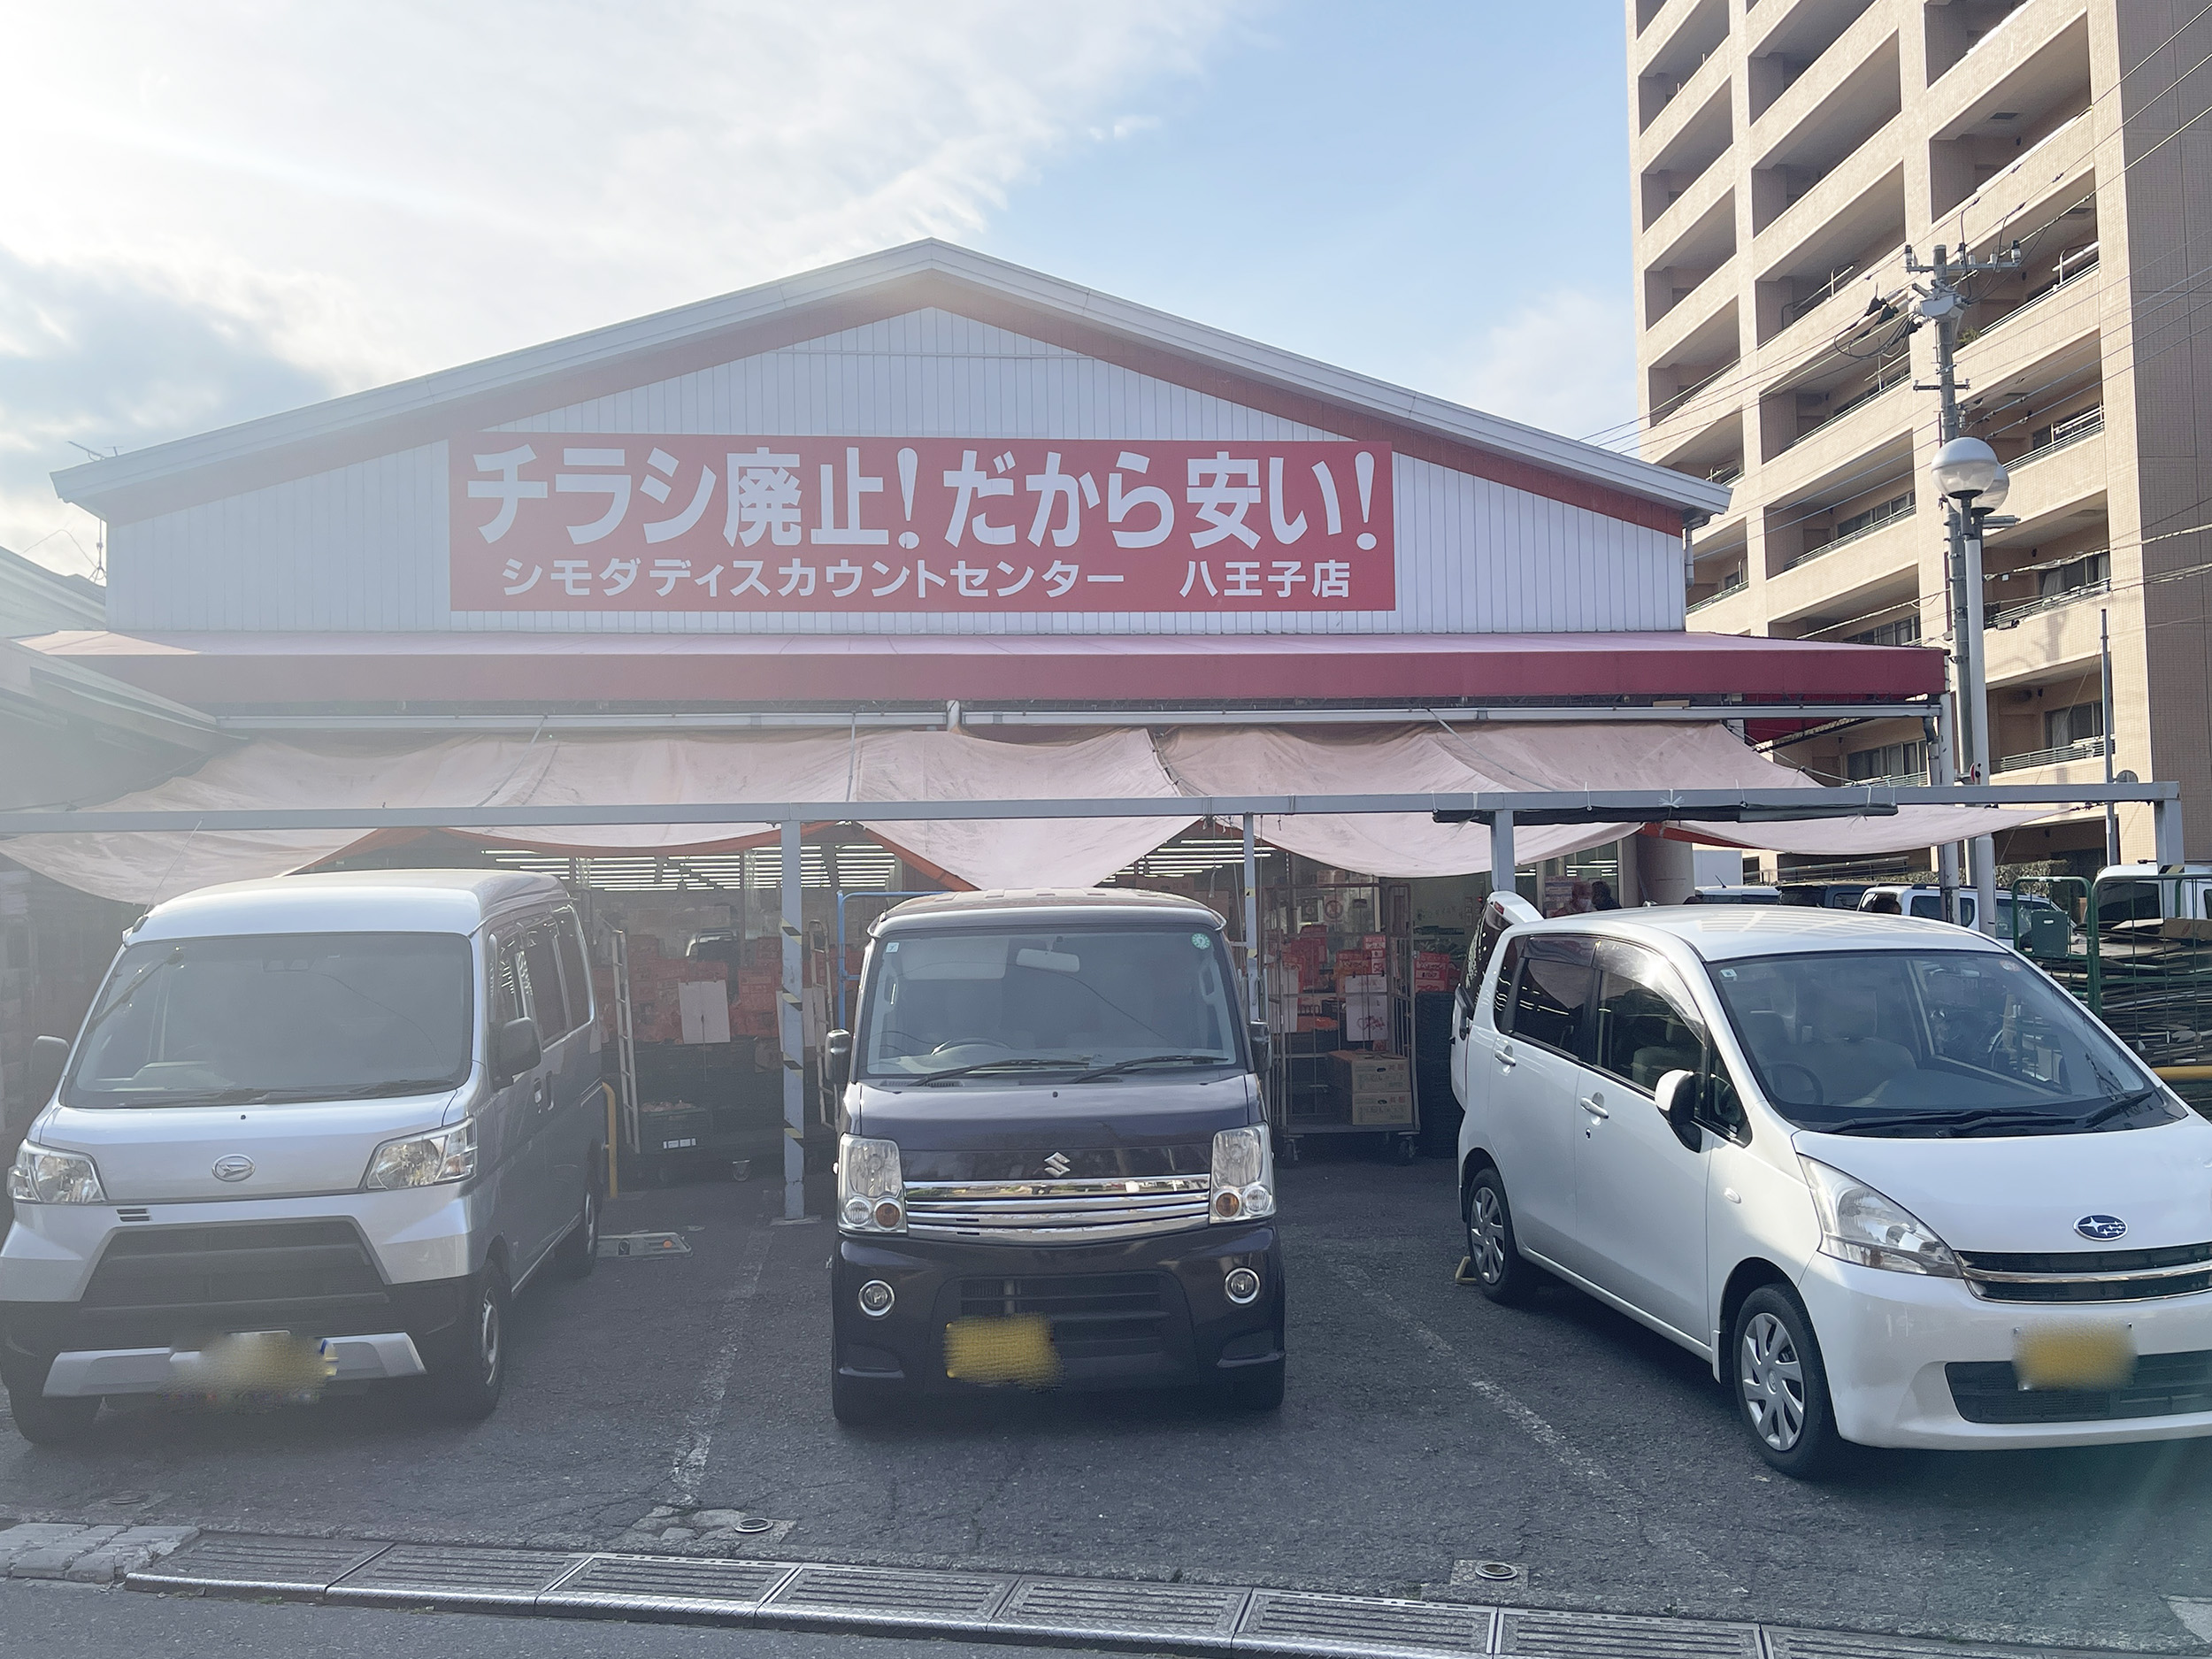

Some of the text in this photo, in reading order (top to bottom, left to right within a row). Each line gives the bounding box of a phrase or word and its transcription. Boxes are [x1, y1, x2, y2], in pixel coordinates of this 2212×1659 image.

[467, 443, 1377, 550] チラシ廃止!だから安い!
[502, 557, 1350, 598] シモダディスカウントセンター 八王子店
